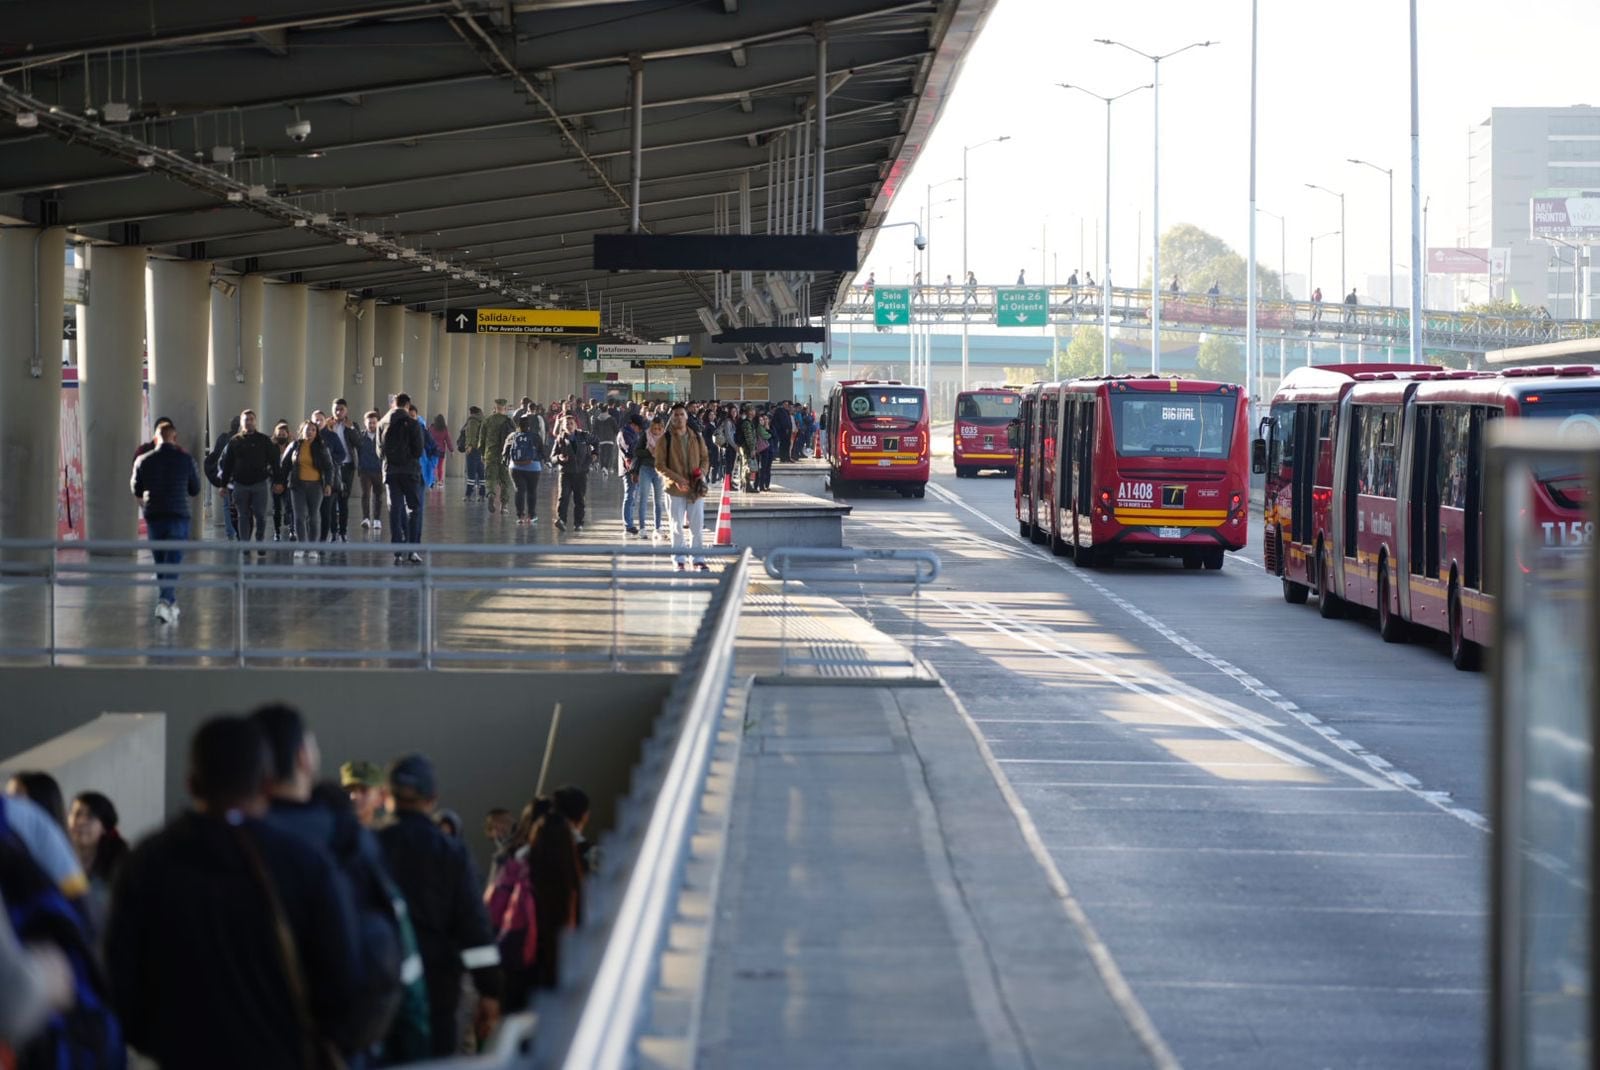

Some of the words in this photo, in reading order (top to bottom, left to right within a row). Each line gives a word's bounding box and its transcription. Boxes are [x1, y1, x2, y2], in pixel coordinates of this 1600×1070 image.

[1535, 212, 1566, 222] PRONTO!
[882, 292, 902, 300] Solo
[1002, 292, 1025, 300] Calle
[1028, 292, 1040, 300] 26
[878, 301, 906, 310] Patios
[852, 436, 877, 444] U1443
[1118, 482, 1153, 499] A1408
